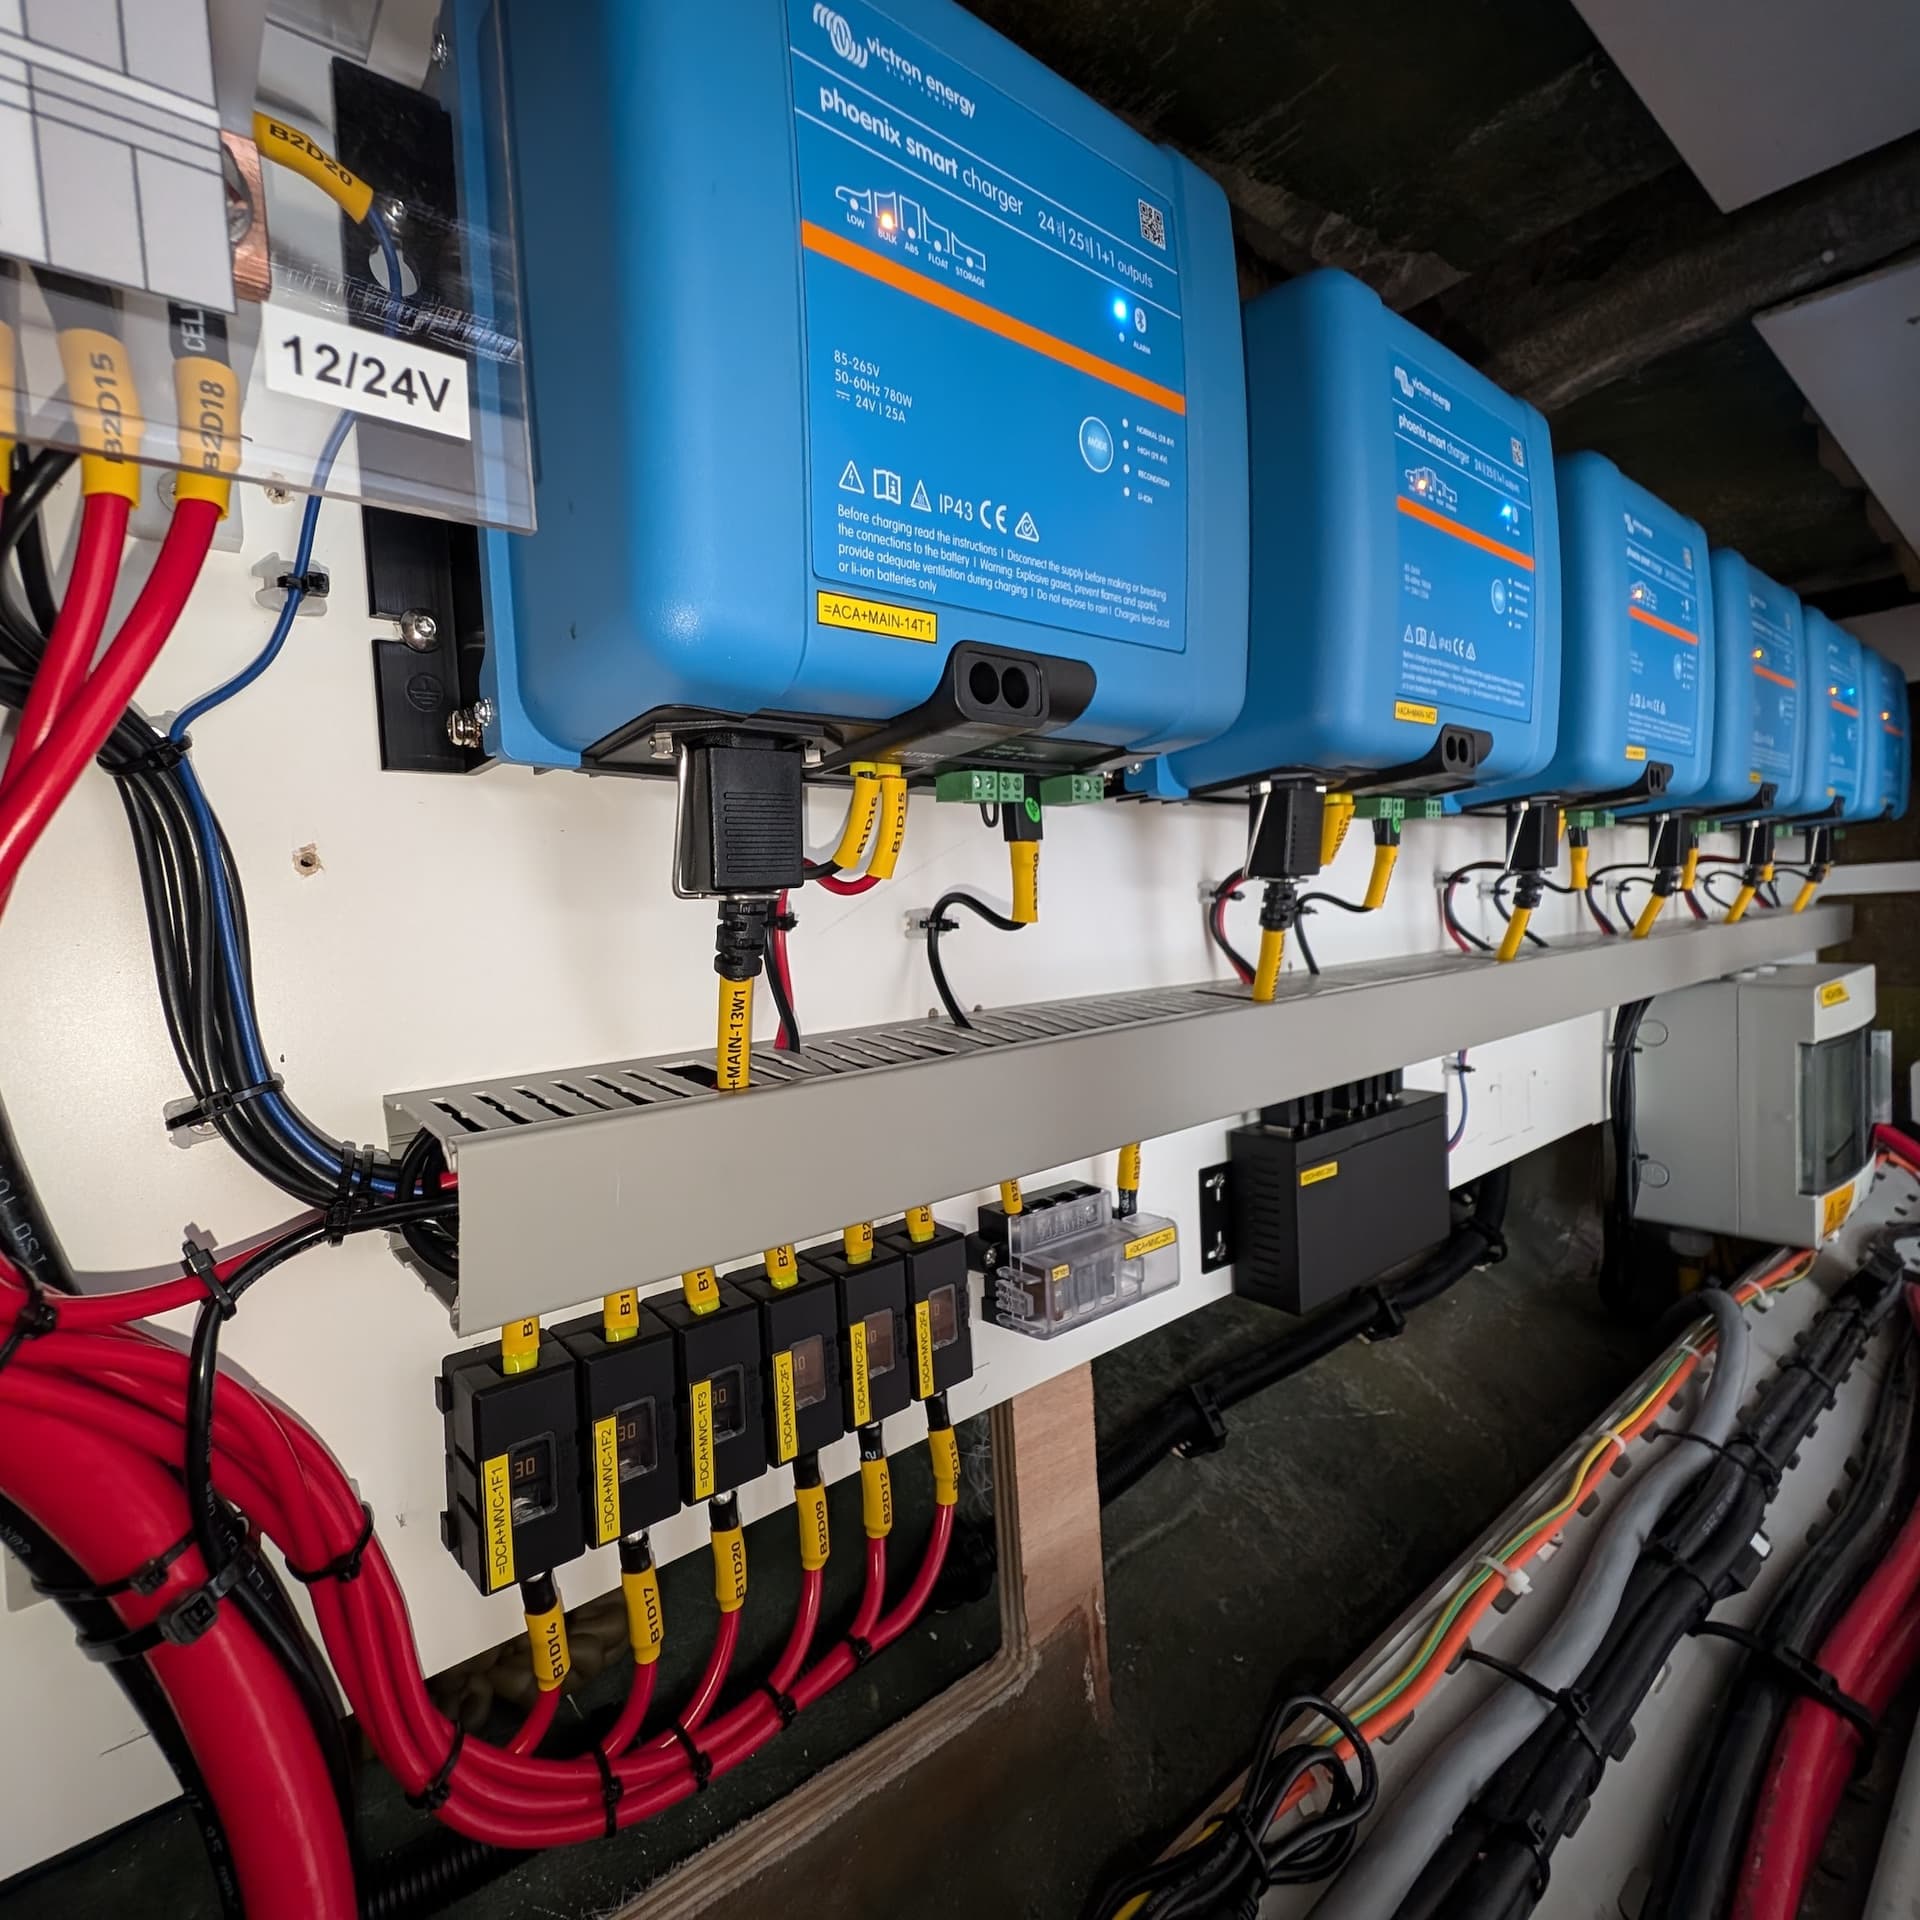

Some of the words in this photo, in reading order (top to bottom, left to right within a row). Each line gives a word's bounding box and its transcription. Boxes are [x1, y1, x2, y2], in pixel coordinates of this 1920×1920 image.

[866, 36, 922, 83] victron
[925, 74, 976, 119] energy
[269, 123, 353, 187] B2D20
[820, 86, 902, 148] phoenix
[906, 136, 959, 180] smart
[962, 168, 1024, 216] charger
[1117, 260, 1153, 289] outputs
[846, 212, 865, 229] LOW
[878, 227, 898, 245] BULK
[904, 241, 919, 256] ABS
[928, 252, 949, 270] FLOAT
[955, 266, 986, 288] STORAGE
[282, 335, 451, 412] 12/24V
[834, 349, 880, 378] 85-265V
[835, 368, 880, 397] 50-60Hz
[884, 386, 913, 408] 780W
[90, 352, 124, 464] B2D15
[199, 379, 225, 473] B2D18
[855, 394, 876, 412] 24V
[885, 404, 906, 424] 25A
[939, 493, 973, 521] IP43
[837, 504, 869, 523] Before
[871, 513, 912, 538] charging
[914, 526, 935, 541] read
[937, 530, 951, 545] the
[952, 534, 997, 557] instructions
[1007, 549, 1047, 570] Disconnect
[1049, 560, 1060, 574] the
[1061, 564, 1083, 582] supply
[1084, 571, 1106, 585] before
[1107, 575, 1131, 594] making
[1132, 583, 1139, 592] or
[1140, 584, 1167, 603] breaking
[838, 523, 853, 538] the
[856, 529, 912, 552] connections
[914, 542, 923, 555] to
[924, 544, 939, 559] the
[940, 548, 970, 568] battery
[1015, 567, 1049, 586] Explosive
[1050, 577, 1073, 593] gases,
[1074, 583, 1100, 599] prevent
[1100, 588, 1122, 603] flames
[1123, 594, 1137, 607] and
[838, 563, 848, 573] or
[851, 562, 875, 578] li-ion
[877, 568, 917, 588] batteries
[918, 579, 938, 595] only
[838, 544, 875, 561] provide
[876, 550, 921, 572] adequate
[922, 561, 965, 581] ventilation
[966, 571, 993, 591] during
[994, 581, 1028, 599] charging
[1036, 588, 1047, 601] Do
[1049, 592, 1060, 604] not
[1061, 598, 1085, 611] expose
[1087, 600, 1095, 611] to
[1095, 604, 1108, 615] rain
[1114, 607, 1140, 623] Charges
[824, 603, 932, 635] =ACA+MAIN-14T1
[726, 989, 746, 1092] +MAIN-13W1
[13, 1223, 46, 1265] ISO
[855, 1330, 866, 1416] =DCA+MVC-2F2
[618, 1422, 636, 1442] 30
[780, 1362, 793, 1450] =DCA+MVC-2F1
[514, 1456, 536, 1480] 30
[698, 1391, 710, 1489] =DCA+MVC-1F3
[602, 1428, 615, 1532] =DCA+MVC-1F2
[880, 1471, 891, 1525] B2D12
[491, 1466, 507, 1576] =DCA+MVC-1F1
[815, 1501, 828, 1556] B2D09
[731, 1541, 745, 1599] B1D20
[643, 1587, 660, 1644] B1D17
[546, 1622, 564, 1680] B1D14
